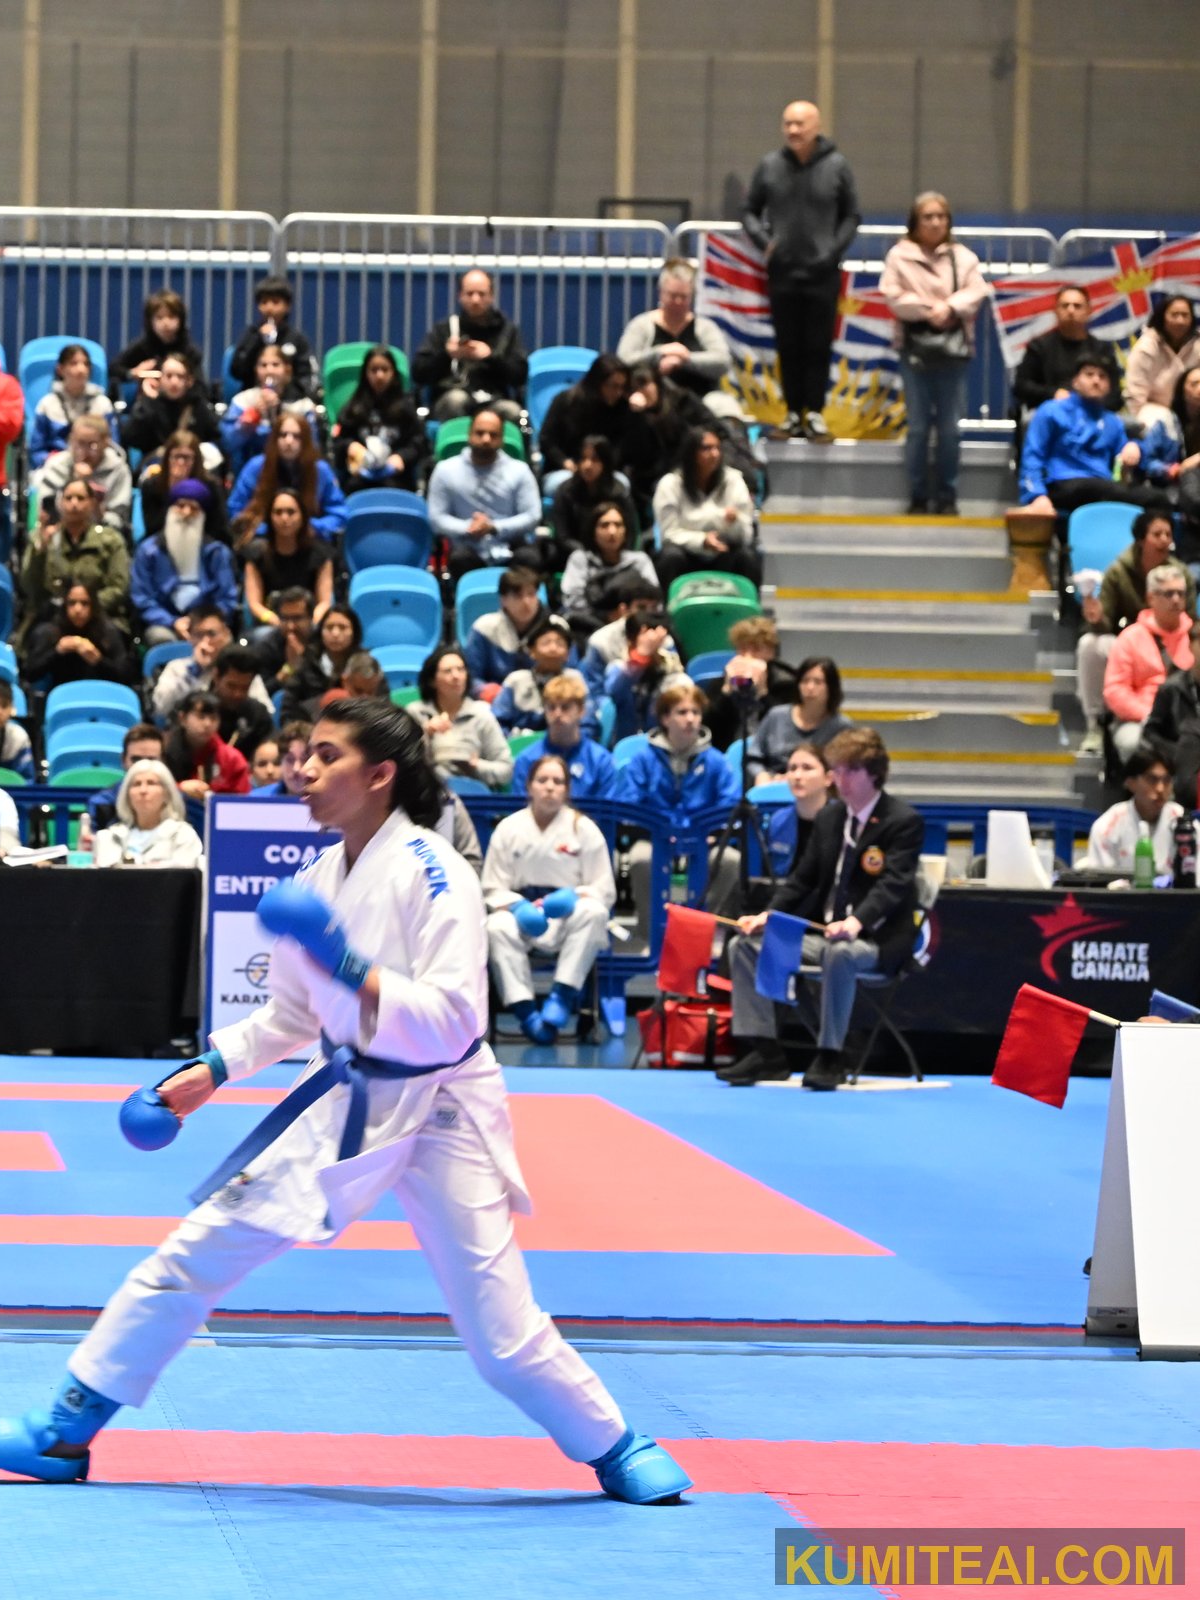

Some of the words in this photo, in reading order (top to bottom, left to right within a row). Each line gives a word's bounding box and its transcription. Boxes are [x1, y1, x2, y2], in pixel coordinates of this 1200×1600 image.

[264, 844, 327, 864] COA
[215, 875, 279, 895] ENTR
[1071, 940, 1150, 962] KARATE
[1071, 960, 1150, 982] CANADA
[220, 994, 273, 1004] KARAT
